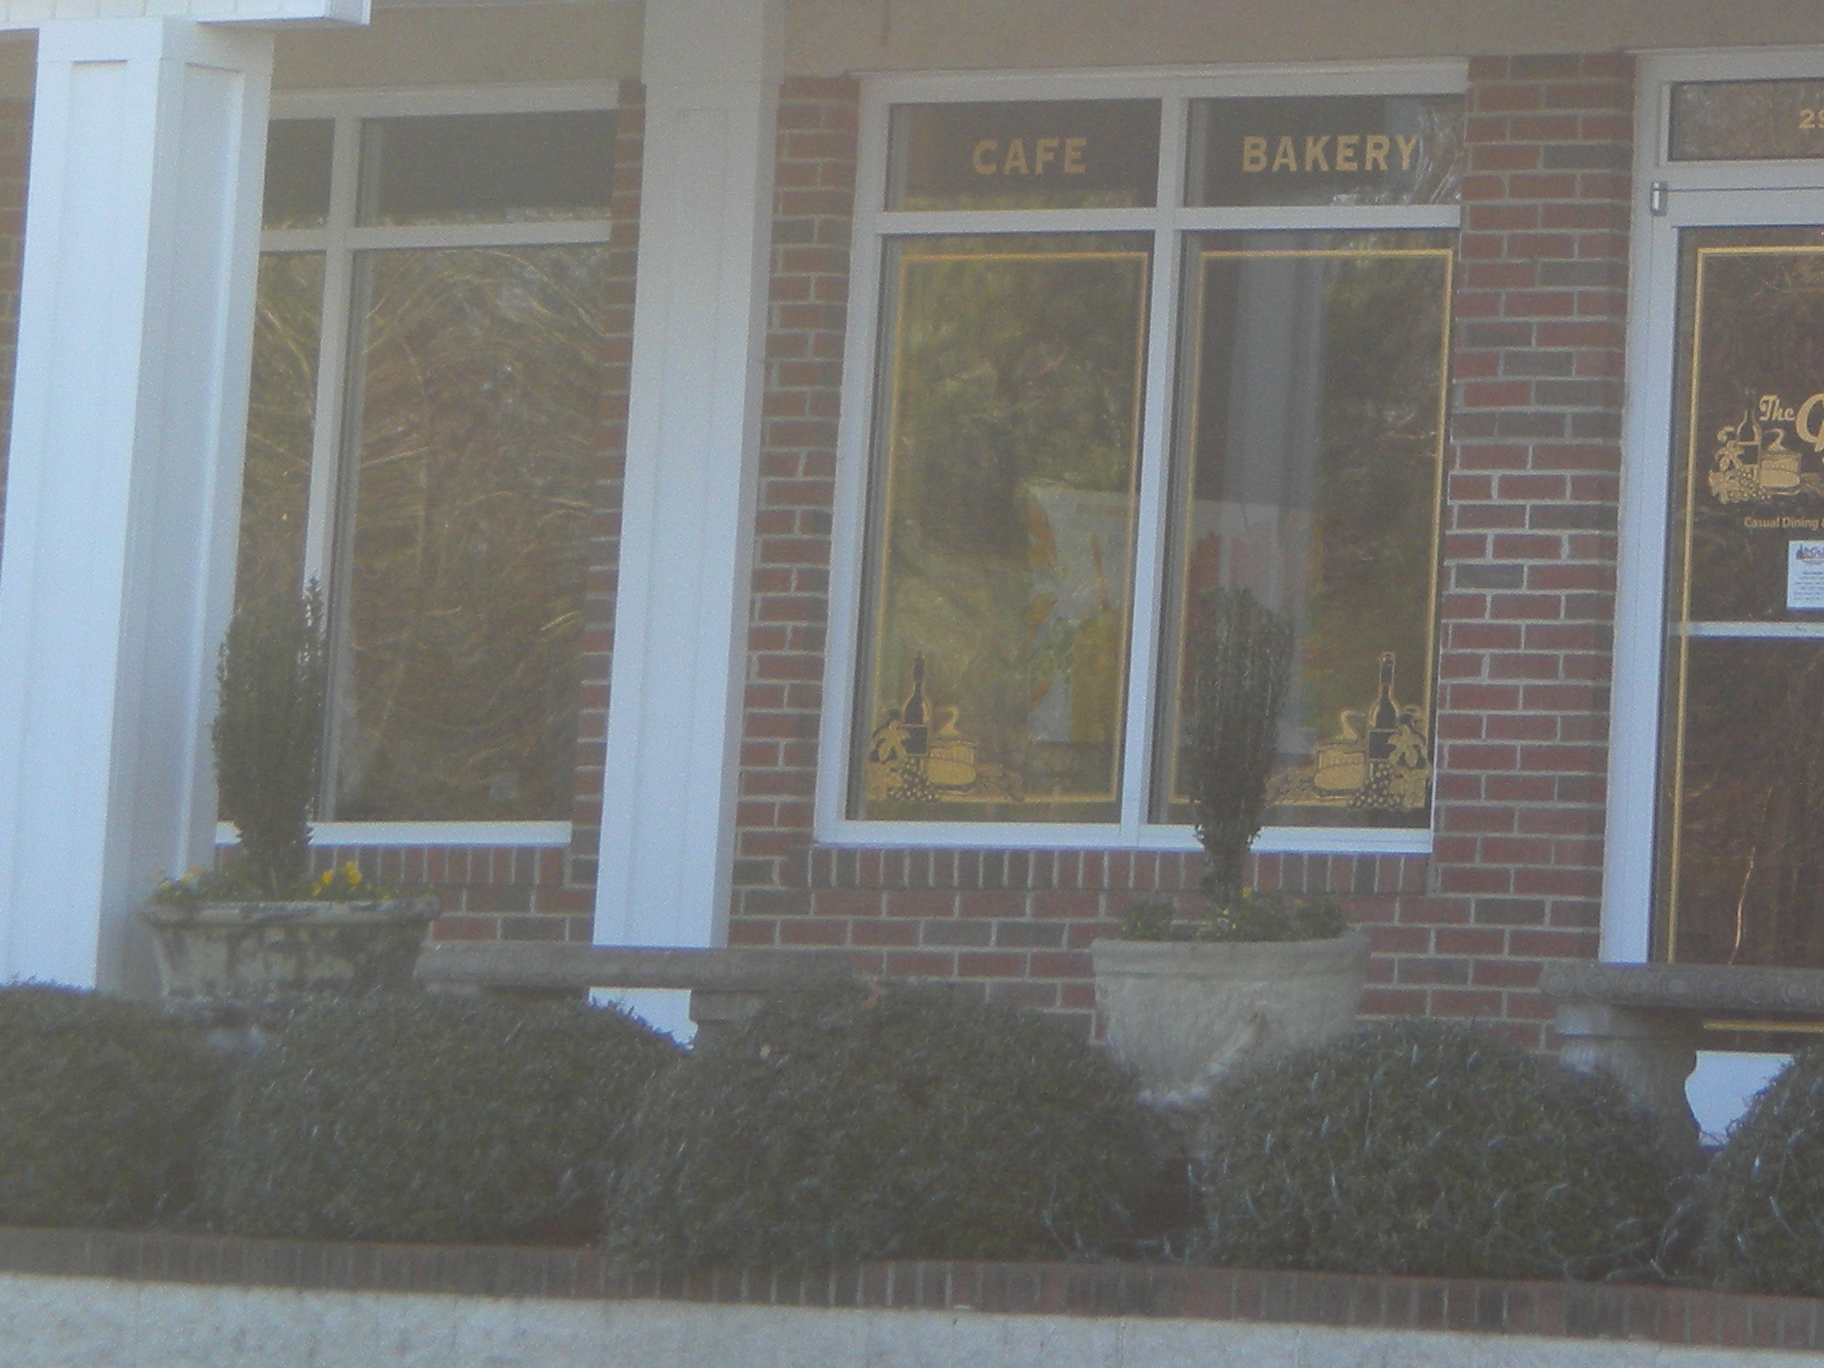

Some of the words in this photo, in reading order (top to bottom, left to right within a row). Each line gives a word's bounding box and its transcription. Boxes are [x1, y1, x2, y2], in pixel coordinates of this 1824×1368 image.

[972, 136, 1089, 176] CAFE
[1241, 133, 1421, 173] BAKERY
[1759, 393, 1796, 422] The
[1743, 516, 1780, 529] Casual
[1782, 516, 1819, 531] Dining
